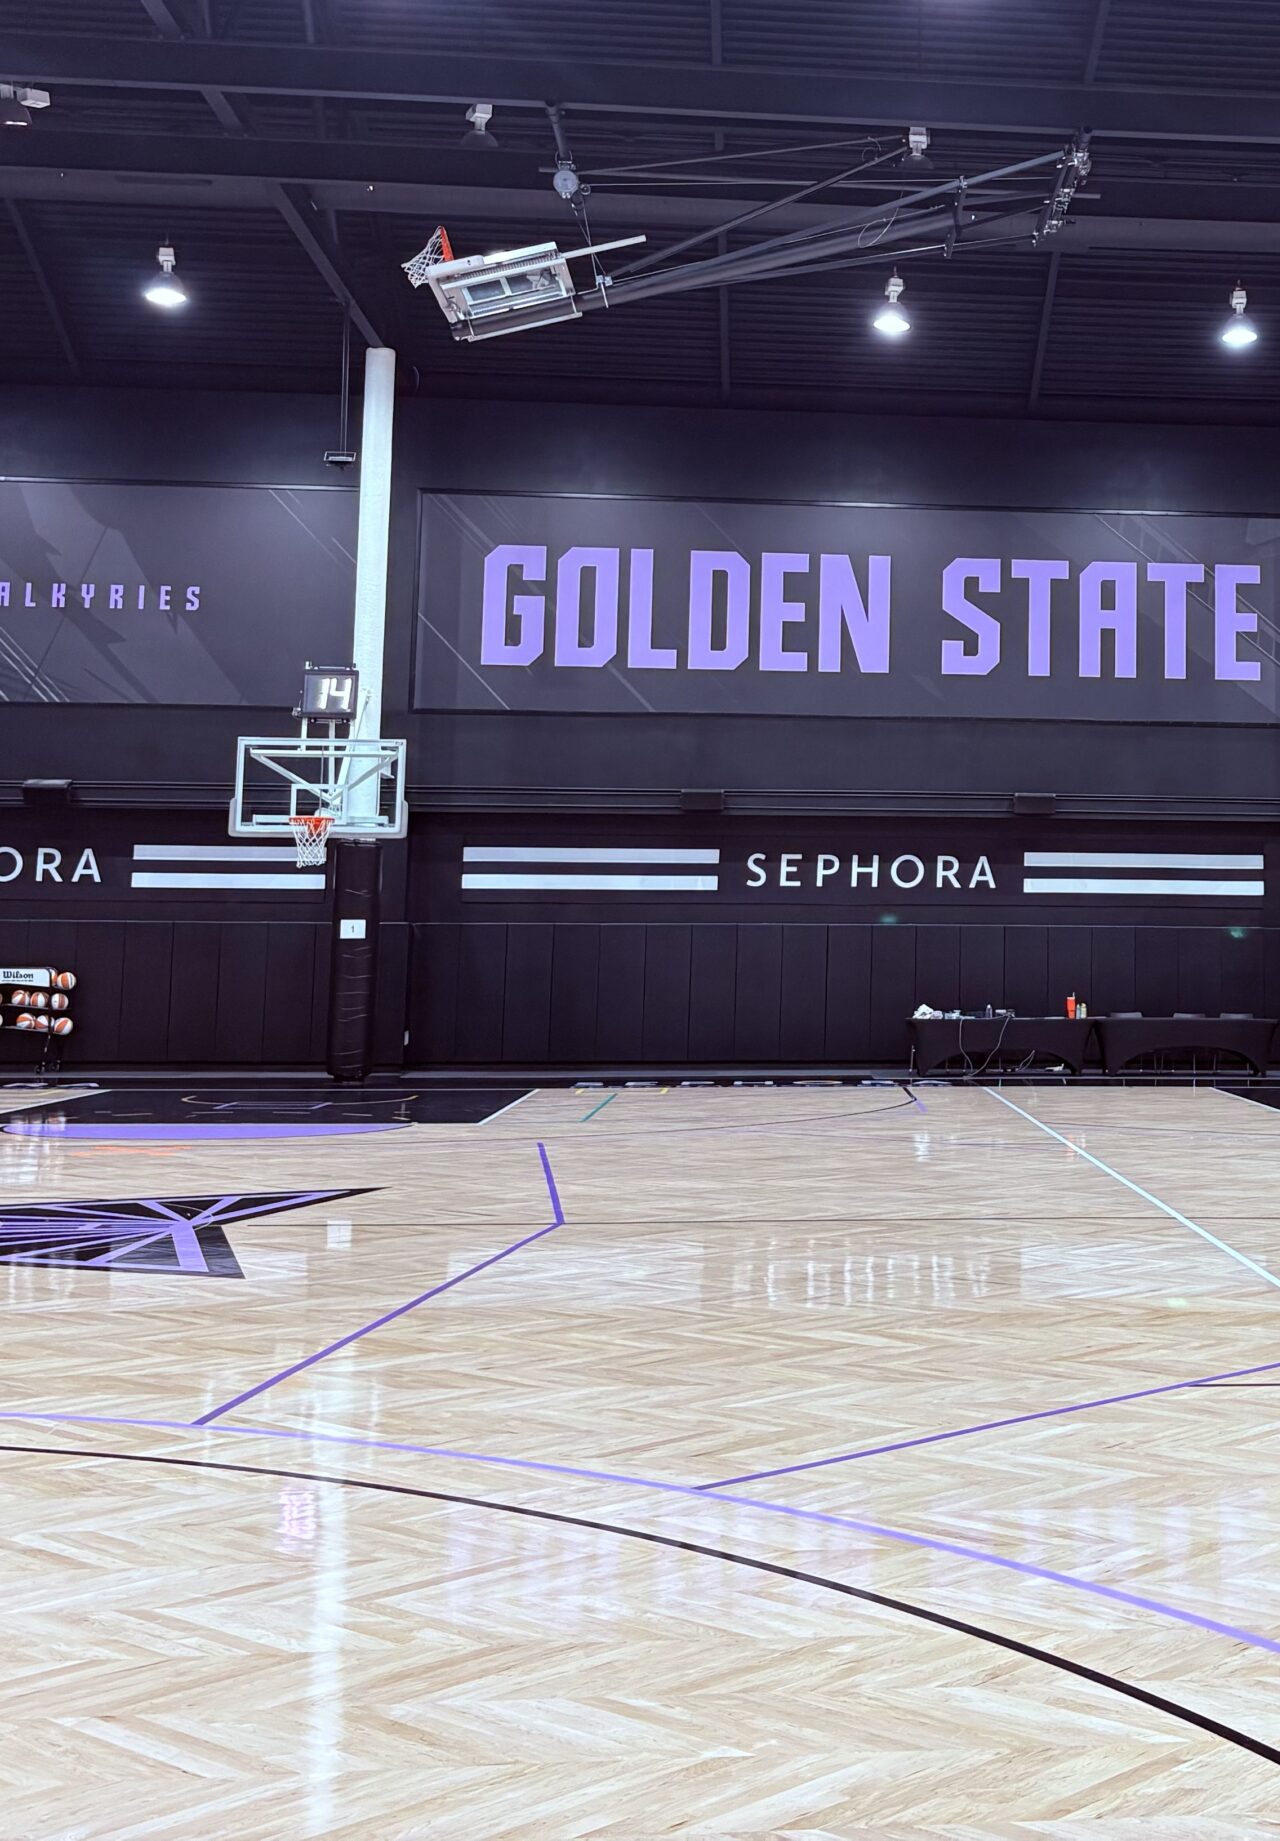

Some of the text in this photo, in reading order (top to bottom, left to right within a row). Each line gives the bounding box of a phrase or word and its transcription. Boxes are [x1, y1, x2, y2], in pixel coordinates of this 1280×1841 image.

[480, 544, 1261, 681] GOLDEN STATE
[317, 677, 353, 710] 14
[0, 846, 102, 882] ORA
[746, 853, 997, 888] SEPHORA
[2, 970, 35, 979] Wilson
